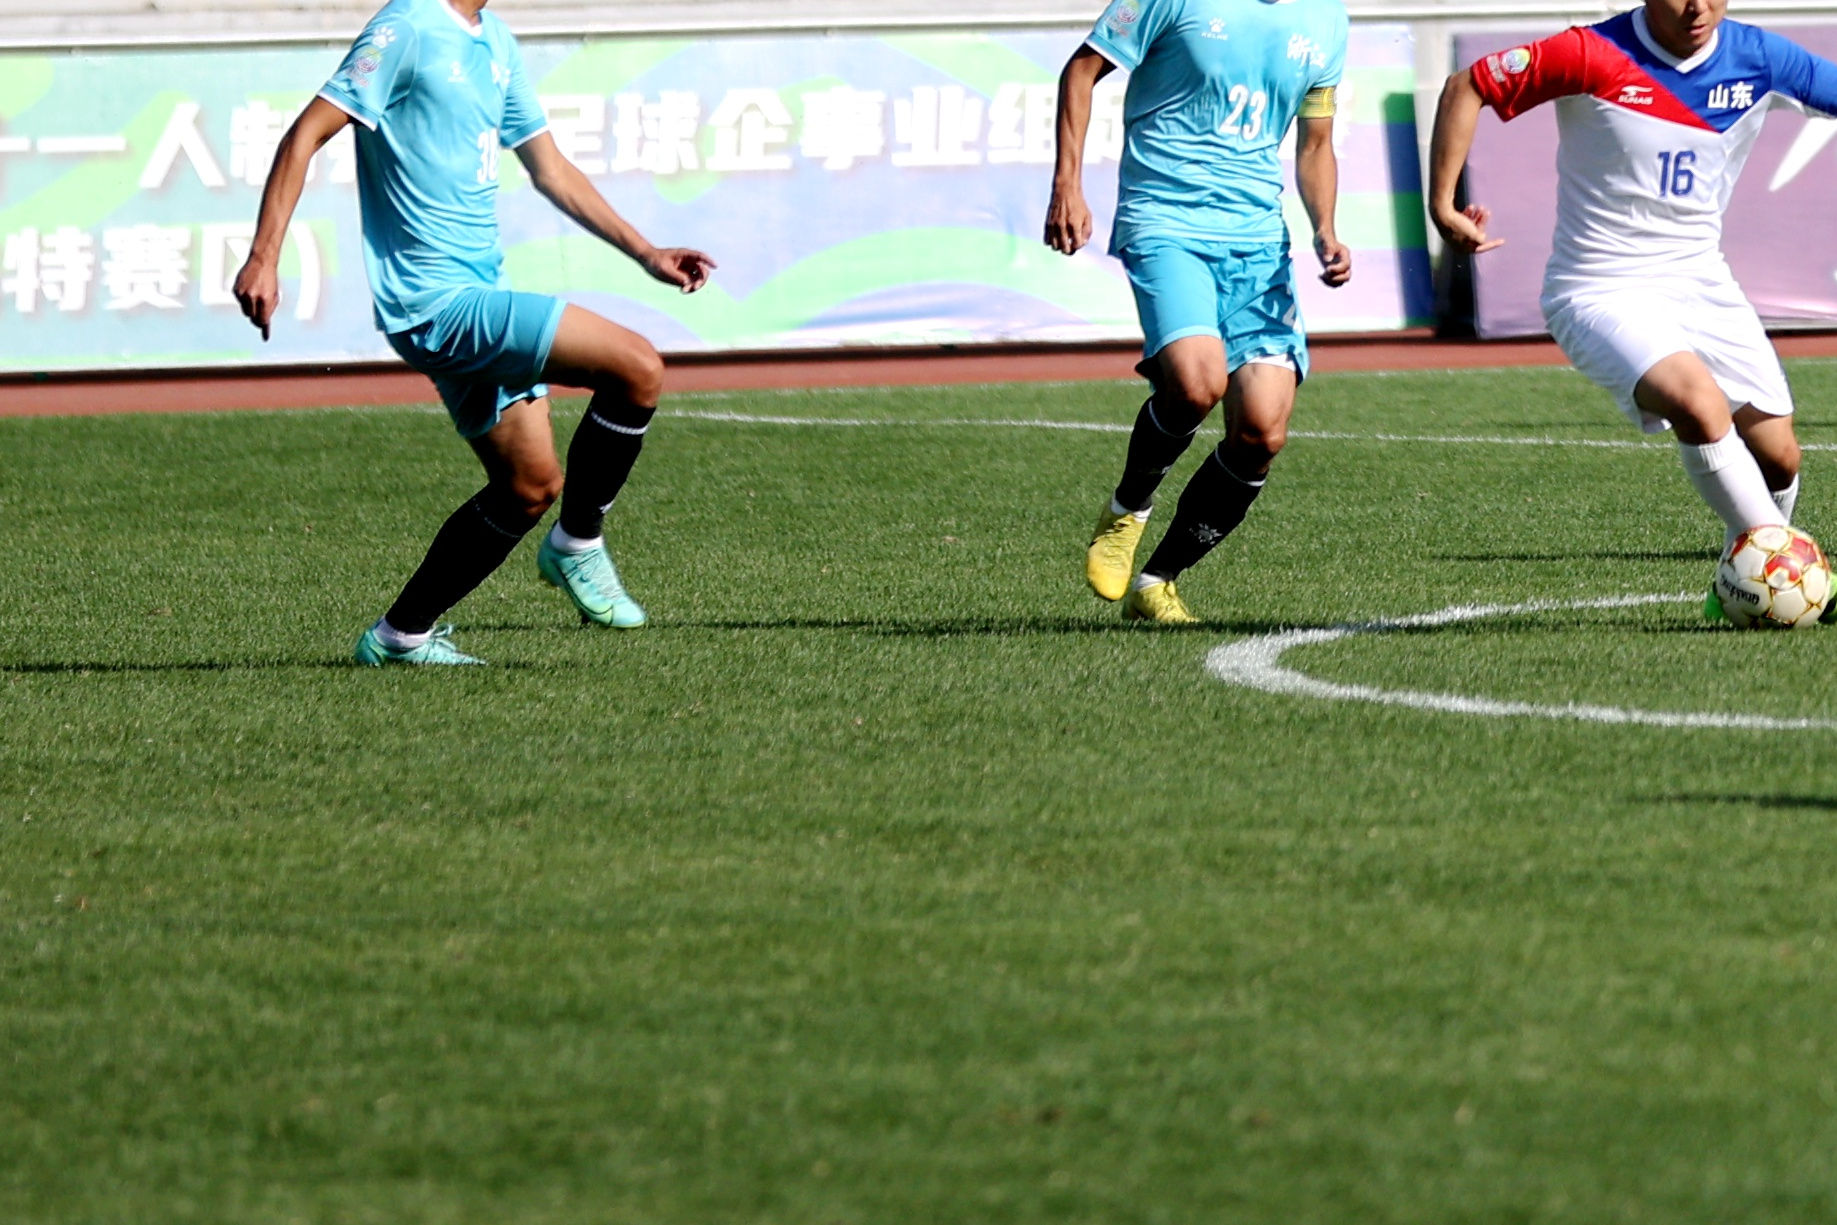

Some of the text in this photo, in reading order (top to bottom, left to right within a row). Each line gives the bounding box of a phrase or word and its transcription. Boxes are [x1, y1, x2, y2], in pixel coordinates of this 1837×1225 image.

[1286, 34, 1326, 70] 浙江
[1219, 84, 1268, 141] 23
[1707, 81, 1754, 110] 山东
[1657, 149, 1697, 200] 16
